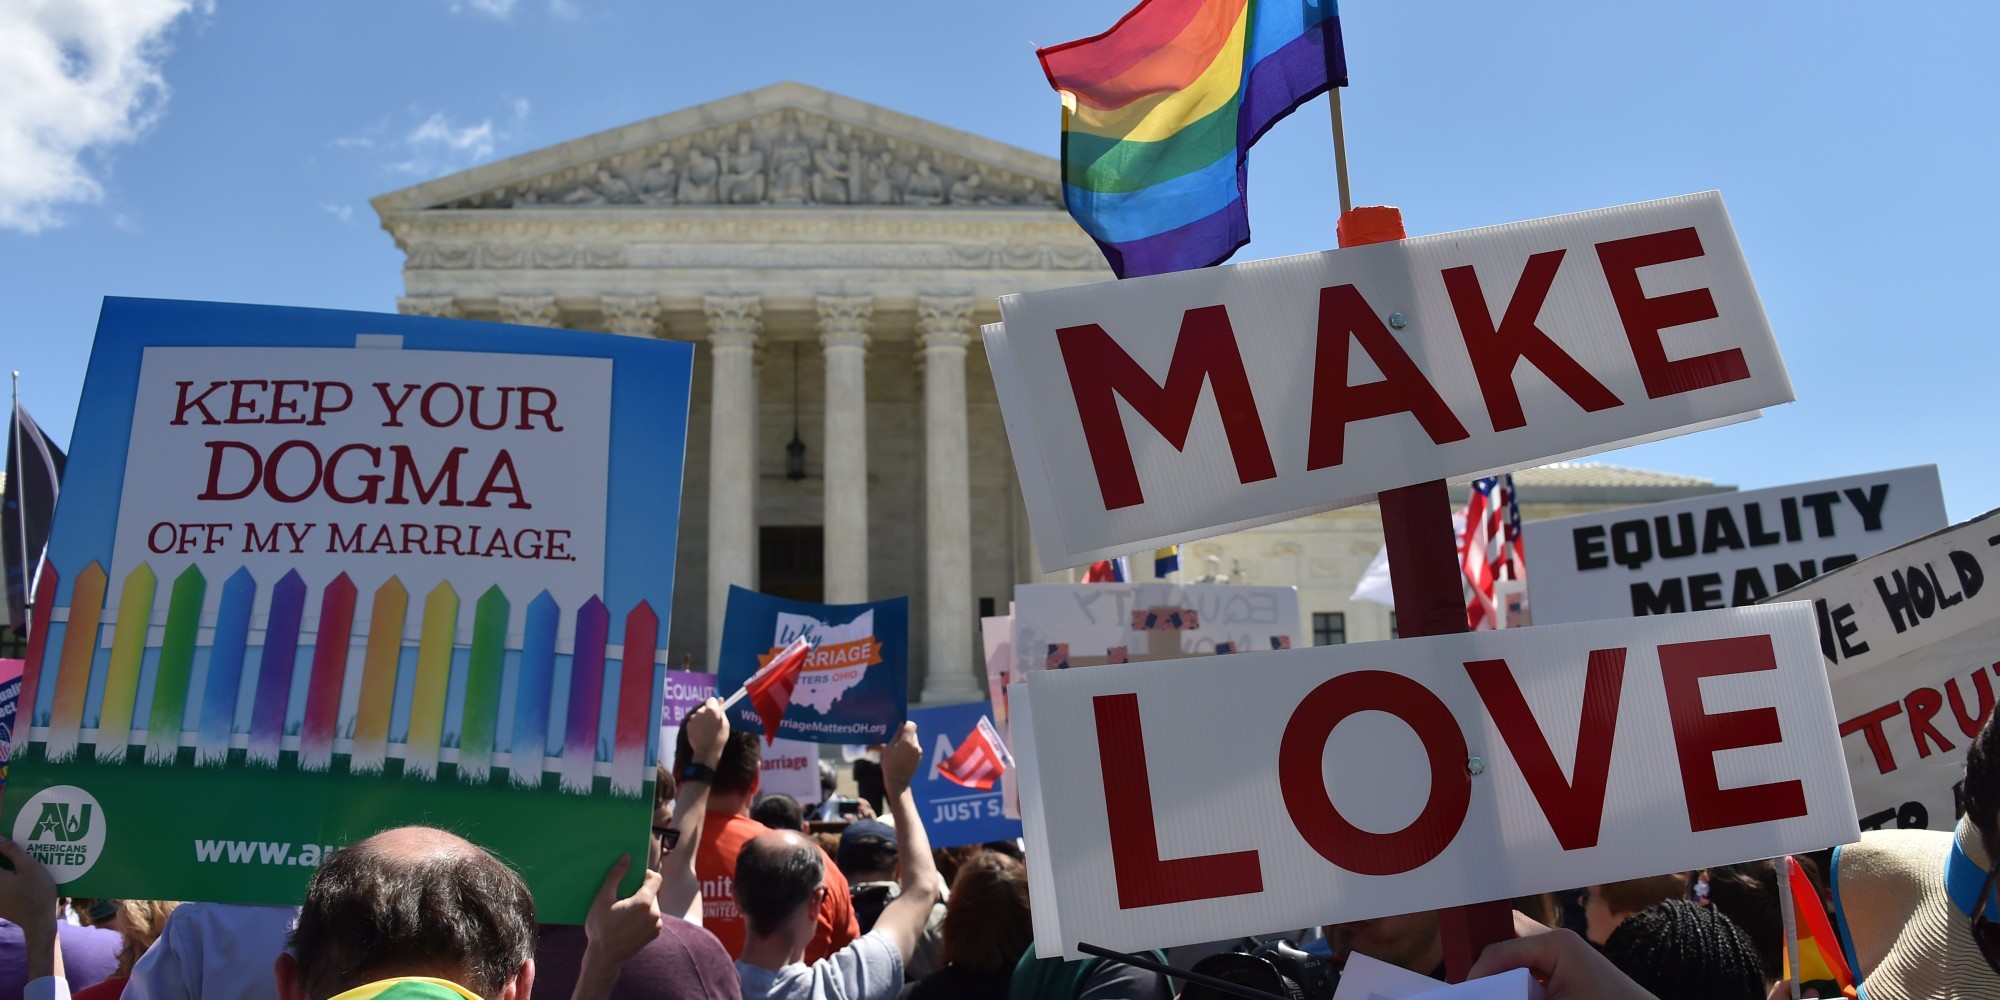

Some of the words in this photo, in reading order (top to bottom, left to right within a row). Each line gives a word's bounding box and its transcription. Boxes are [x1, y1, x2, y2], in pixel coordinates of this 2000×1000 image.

[1056, 227, 1750, 510] MAKE
[170, 379, 353, 427] KEEP
[372, 382, 563, 432] YOUR
[197, 440, 532, 510] DOGMA
[147, 522, 232, 554] OFF
[242, 522, 316, 553] MY
[326, 523, 578, 562] MARRIAGE.
[1574, 484, 1890, 571] EQUALITY
[1630, 554, 1858, 616] MEAN
[1874, 550, 1984, 634] HOLD
[780, 623, 823, 652] Why
[802, 643, 872, 668] RRIAGE
[799, 674, 829, 685] TERS
[832, 670, 858, 682] OHIO
[741, 709, 887, 736] WhyrriageMattersOH.org
[1840, 660, 2000, 775] TRU
[760, 755, 808, 771] arriage
[1093, 635, 1807, 910] LOVE
[933, 800, 982, 824] JUST
[987, 798, 1006, 817] S
[26, 844, 87, 853] AMERICANS
